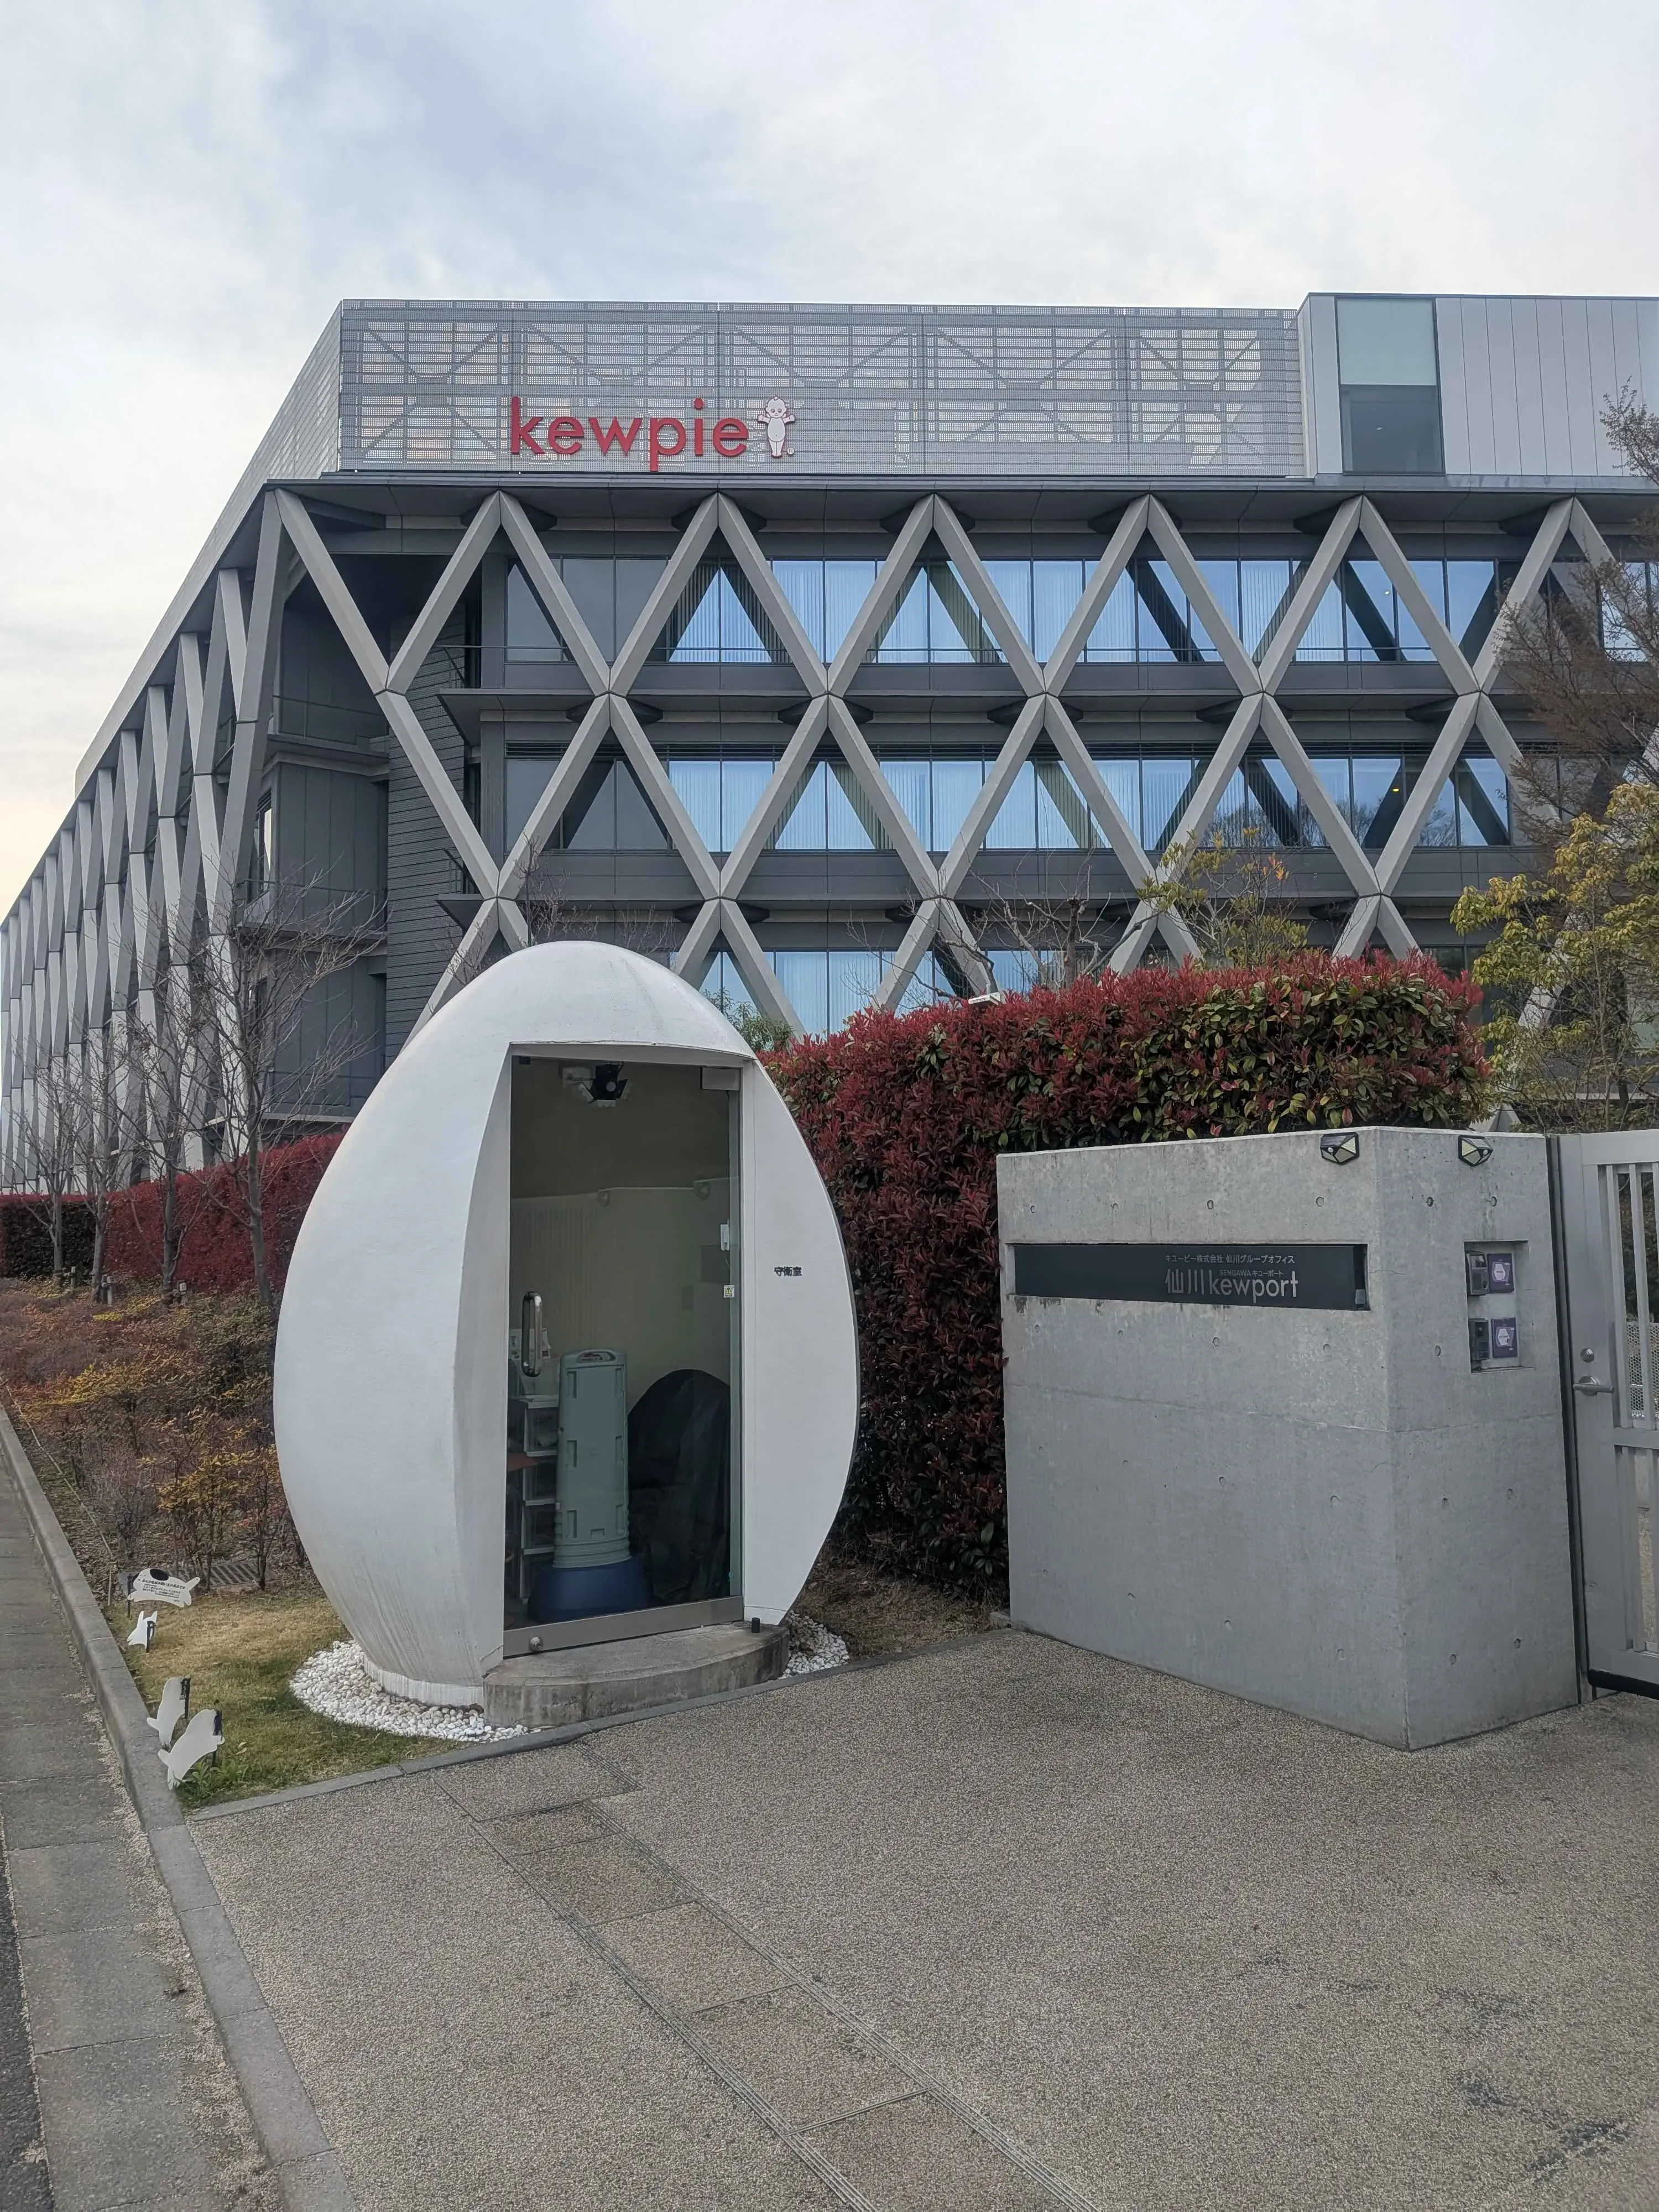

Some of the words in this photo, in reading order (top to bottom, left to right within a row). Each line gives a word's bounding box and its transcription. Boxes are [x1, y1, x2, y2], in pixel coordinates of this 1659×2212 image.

[511, 394, 750, 472] kewpie
[774, 1266, 802, 1276] 守衛室
